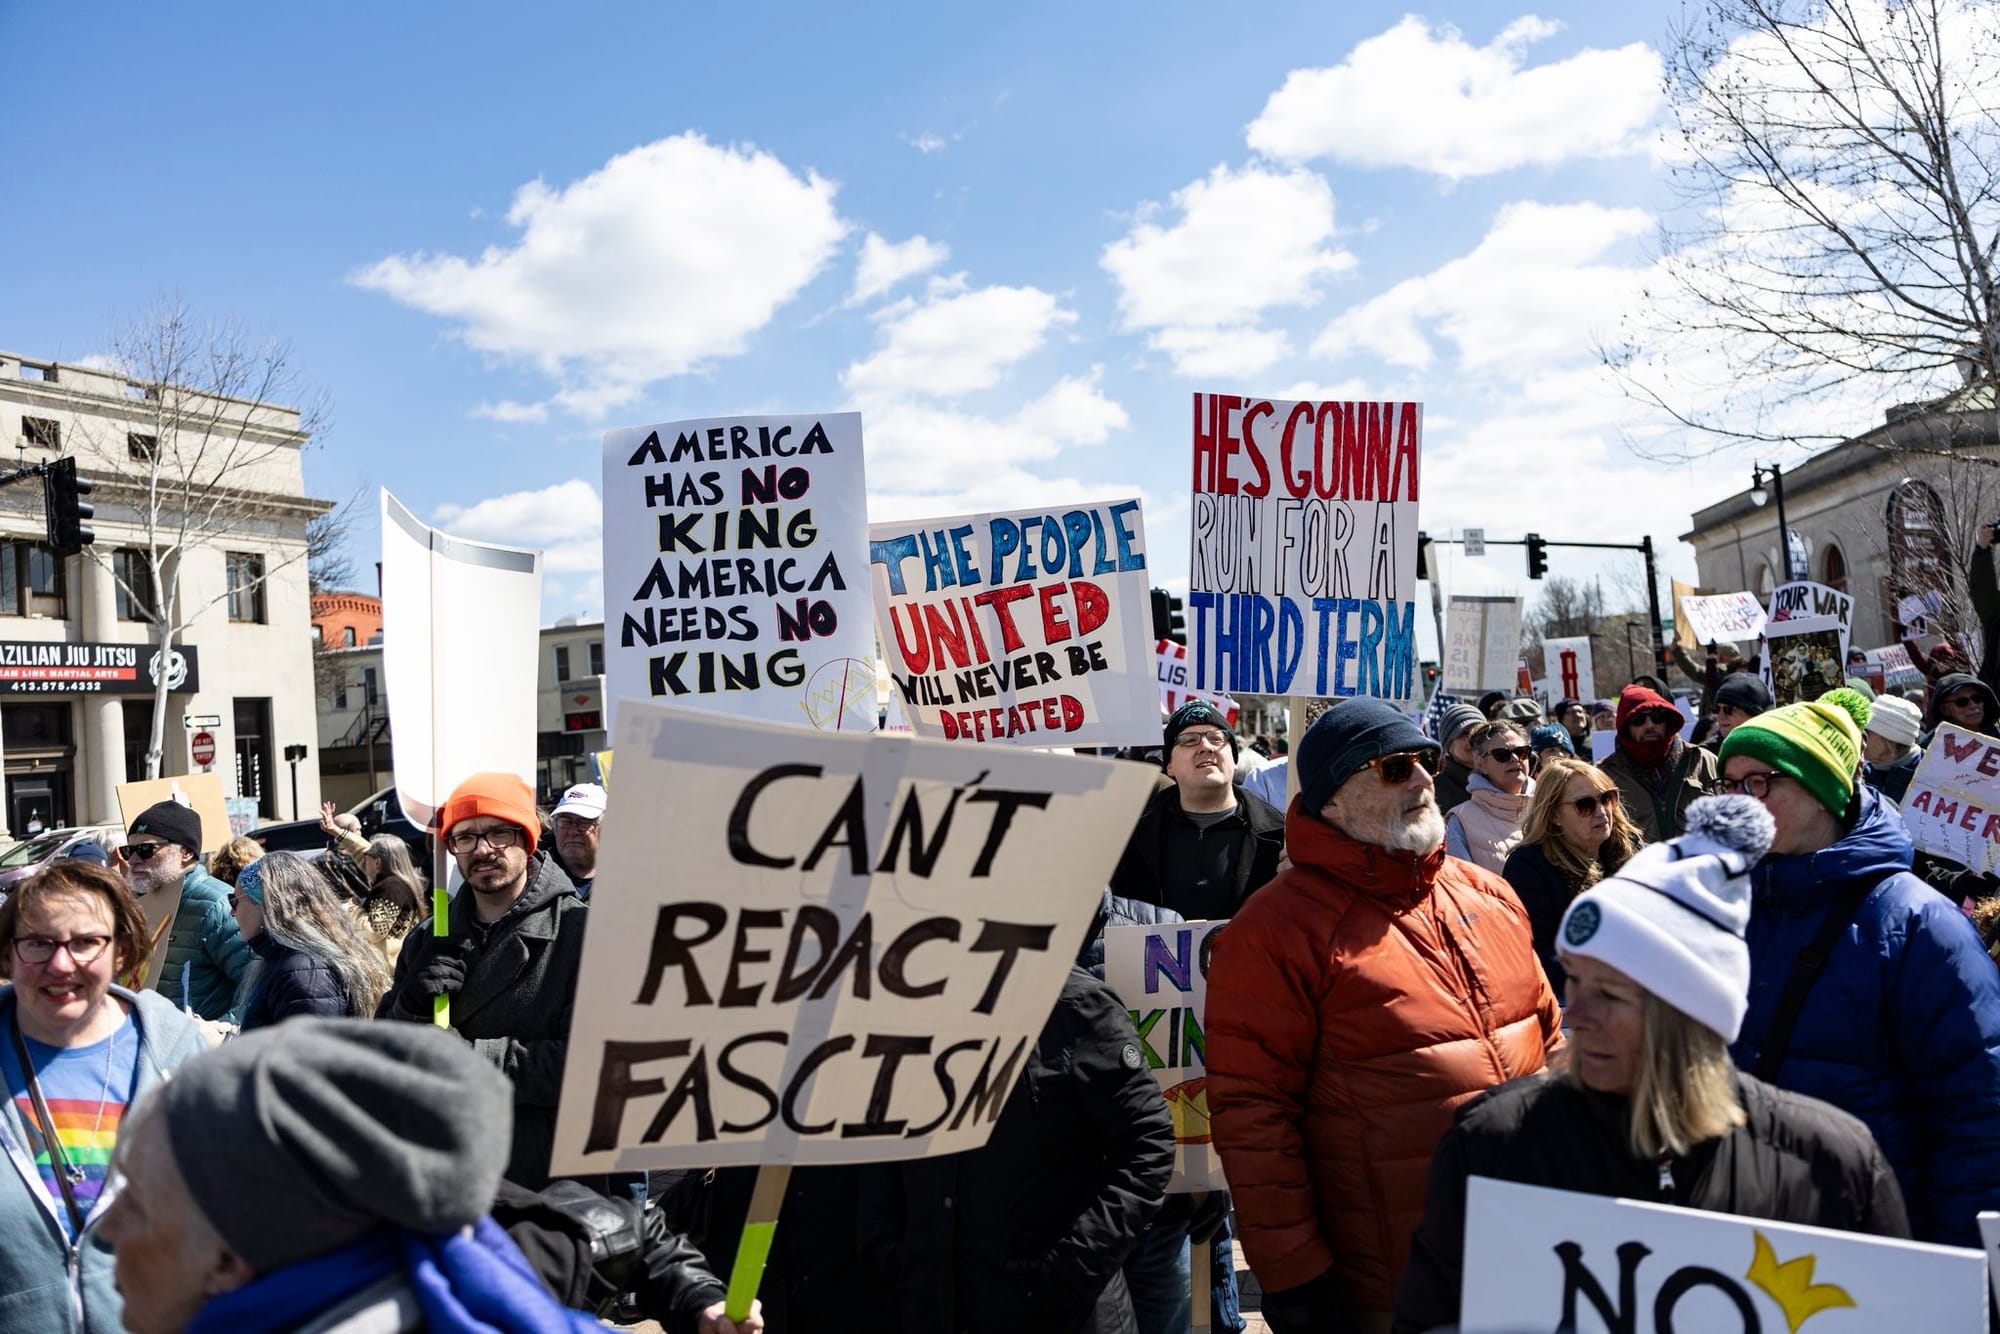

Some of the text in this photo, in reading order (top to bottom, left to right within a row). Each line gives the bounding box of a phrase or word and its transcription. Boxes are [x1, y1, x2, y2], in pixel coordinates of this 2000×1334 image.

[627, 421, 834, 466] AMERICA
[1193, 392, 1418, 501] HE'S GONNA
[644, 464, 810, 507] HAS NO
[658, 508, 818, 554] KING
[869, 500, 1146, 596] THE PEOPLE
[1191, 491, 1397, 600] RUN FOR A
[633, 551, 847, 601] AMERICA
[621, 597, 838, 648] NEEDS NO
[889, 581, 1110, 675] UNITED
[1775, 586, 1850, 625] YOUR WAR
[65, 645, 90, 666] JIU
[94, 646, 136, 667] JITSU
[650, 649, 805, 697] KING
[891, 641, 1108, 705] WILL NEVER BE
[1190, 592, 1416, 700] THIRD TERM
[939, 694, 1085, 742] DEFEATED
[1943, 733, 2000, 777] WE
[727, 763, 1054, 879] CAN'T
[632, 901, 1057, 1015] REDACT
[583, 1031, 1028, 1155] FASCISM
[1552, 1240, 1762, 1334] NO
